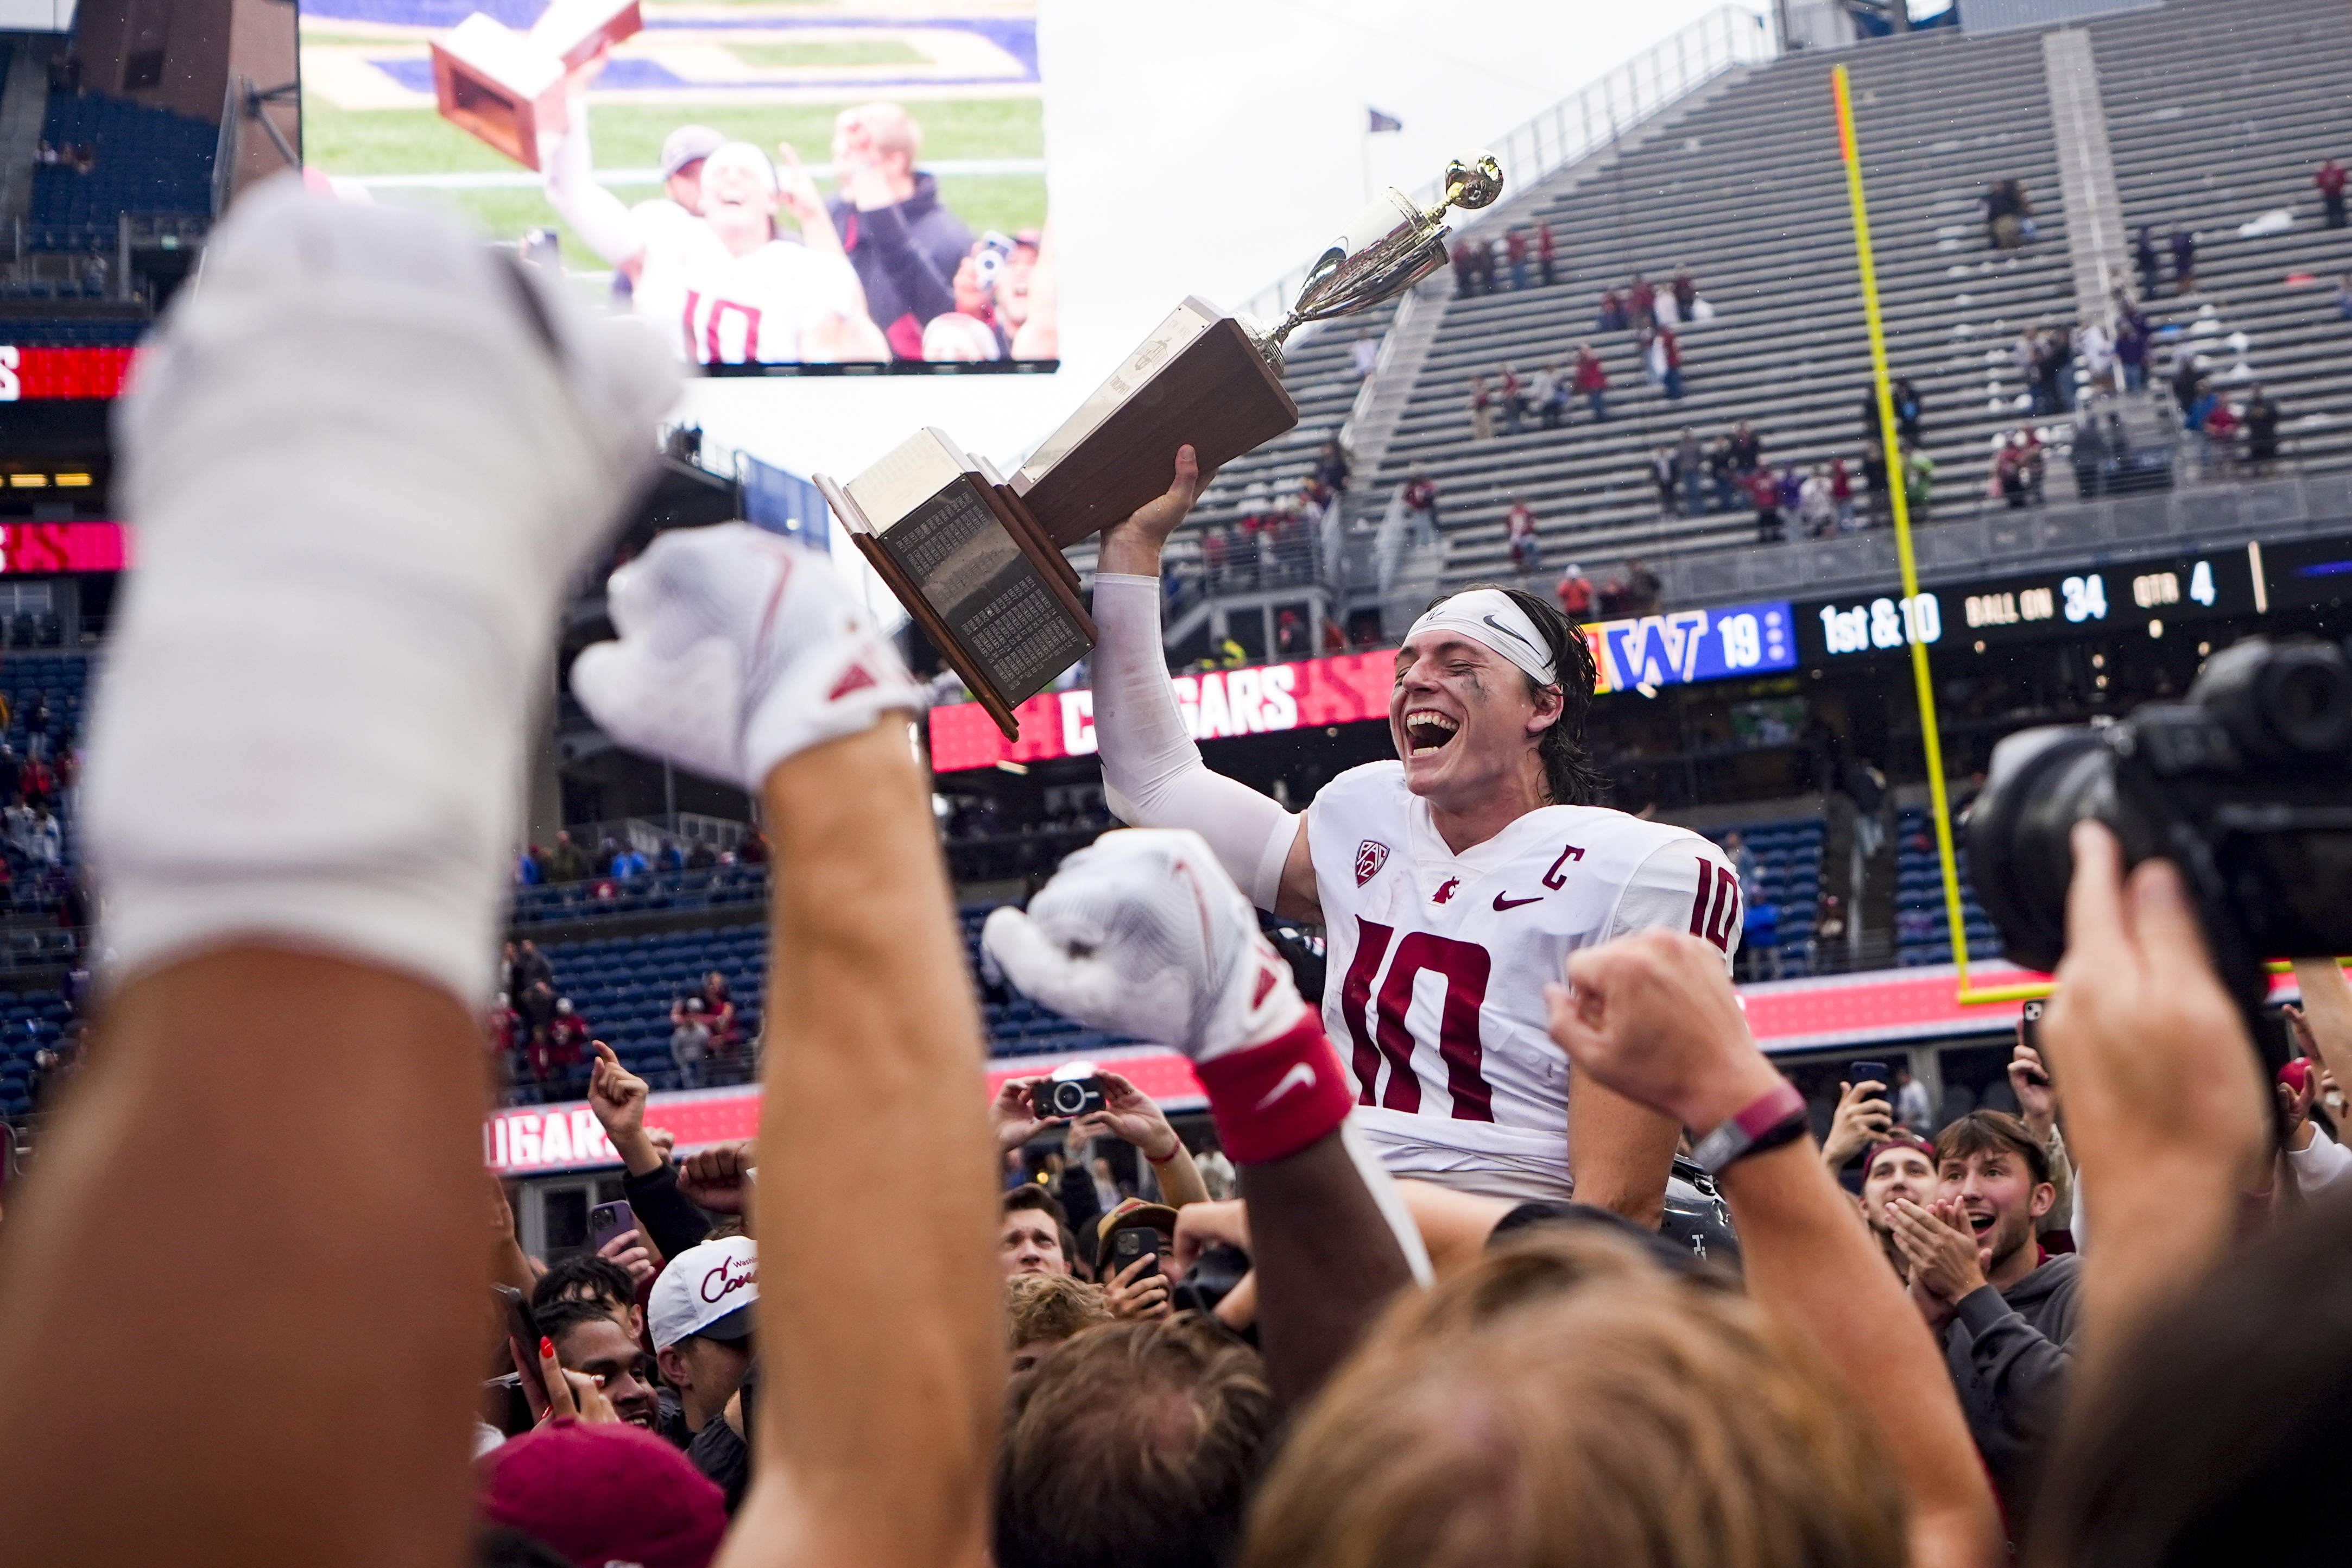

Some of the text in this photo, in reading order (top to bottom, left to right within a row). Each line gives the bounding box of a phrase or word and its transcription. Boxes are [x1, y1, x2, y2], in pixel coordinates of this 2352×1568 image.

[684, 290, 762, 363] 10
[1109, 375, 1131, 395] TROPHY
[941, 526, 961, 549] COUGARS
[947, 521, 966, 543] HUSKIES
[953, 517, 972, 539] HUSKIES
[959, 513, 977, 534] HUSKIE
[964, 508, 984, 530] HUSKIES
[971, 504, 989, 524] HUSKIE
[895, 539, 926, 577] 1973 COUGARS
[901, 535, 932, 572] 1972 COUGARS
[907, 530, 920, 544] 1971
[918, 543, 937, 565] HUSKIES
[919, 521, 932, 536] 19
[929, 535, 948, 557] HUSKIES
[923, 539, 942, 561] HUSKIES
[935, 530, 955, 554] COUGARS
[1011, 583, 1024, 597] 1976
[1022, 597, 1040, 618] HUSKIES
[1041, 623, 1061, 646] COUGARS
[1024, 574, 1036, 588] 1974
[1034, 587, 1052, 609] HUSKIES
[1054, 615, 1073, 638] COUGARS
[1027, 592, 1046, 614] HUSKIES
[1048, 619, 1068, 642] COUGARS
[1964, 560, 2216, 628] BALL ON 34 QTR 4
[993, 618, 1011, 640] HUSKIES
[1014, 645, 1033, 667] COUGARS
[999, 614, 1017, 635] HUSKIES
[1020, 641, 1039, 663] COUGARS
[1000, 592, 1013, 606] 1978
[1010, 605, 1029, 627] HUSKIES
[1030, 632, 1051, 655] COUGARS
[1004, 609, 1023, 631] HUSKIES
[1025, 636, 1045, 659] COUGARS
[1006, 587, 1019, 602] 1977
[1016, 600, 1035, 622] HUSKIES
[1036, 628, 1057, 651] COUGARS
[970, 635, 990, 658] COUGARS
[992, 663, 1010, 684] HUSKIES
[976, 631, 995, 653] HUSKIES
[996, 657, 1016, 680] COUGARS
[982, 626, 1002, 649] COUGARS
[1003, 654, 1022, 676] HUSKIES
[987, 622, 1007, 646] COUGARS
[1009, 650, 1027, 672] HUSKIES
[1603, 609, 1762, 691] W 19
[1059, 665, 1298, 756] CGARS
[1356, 841, 1388, 871] PAC
[1357, 859, 1375, 877] 12
[1542, 845, 1585, 891] C
[1689, 856, 1738, 952] 10
[1342, 914, 1495, 1123] 10
[733, 1256, 758, 1268] Washi
